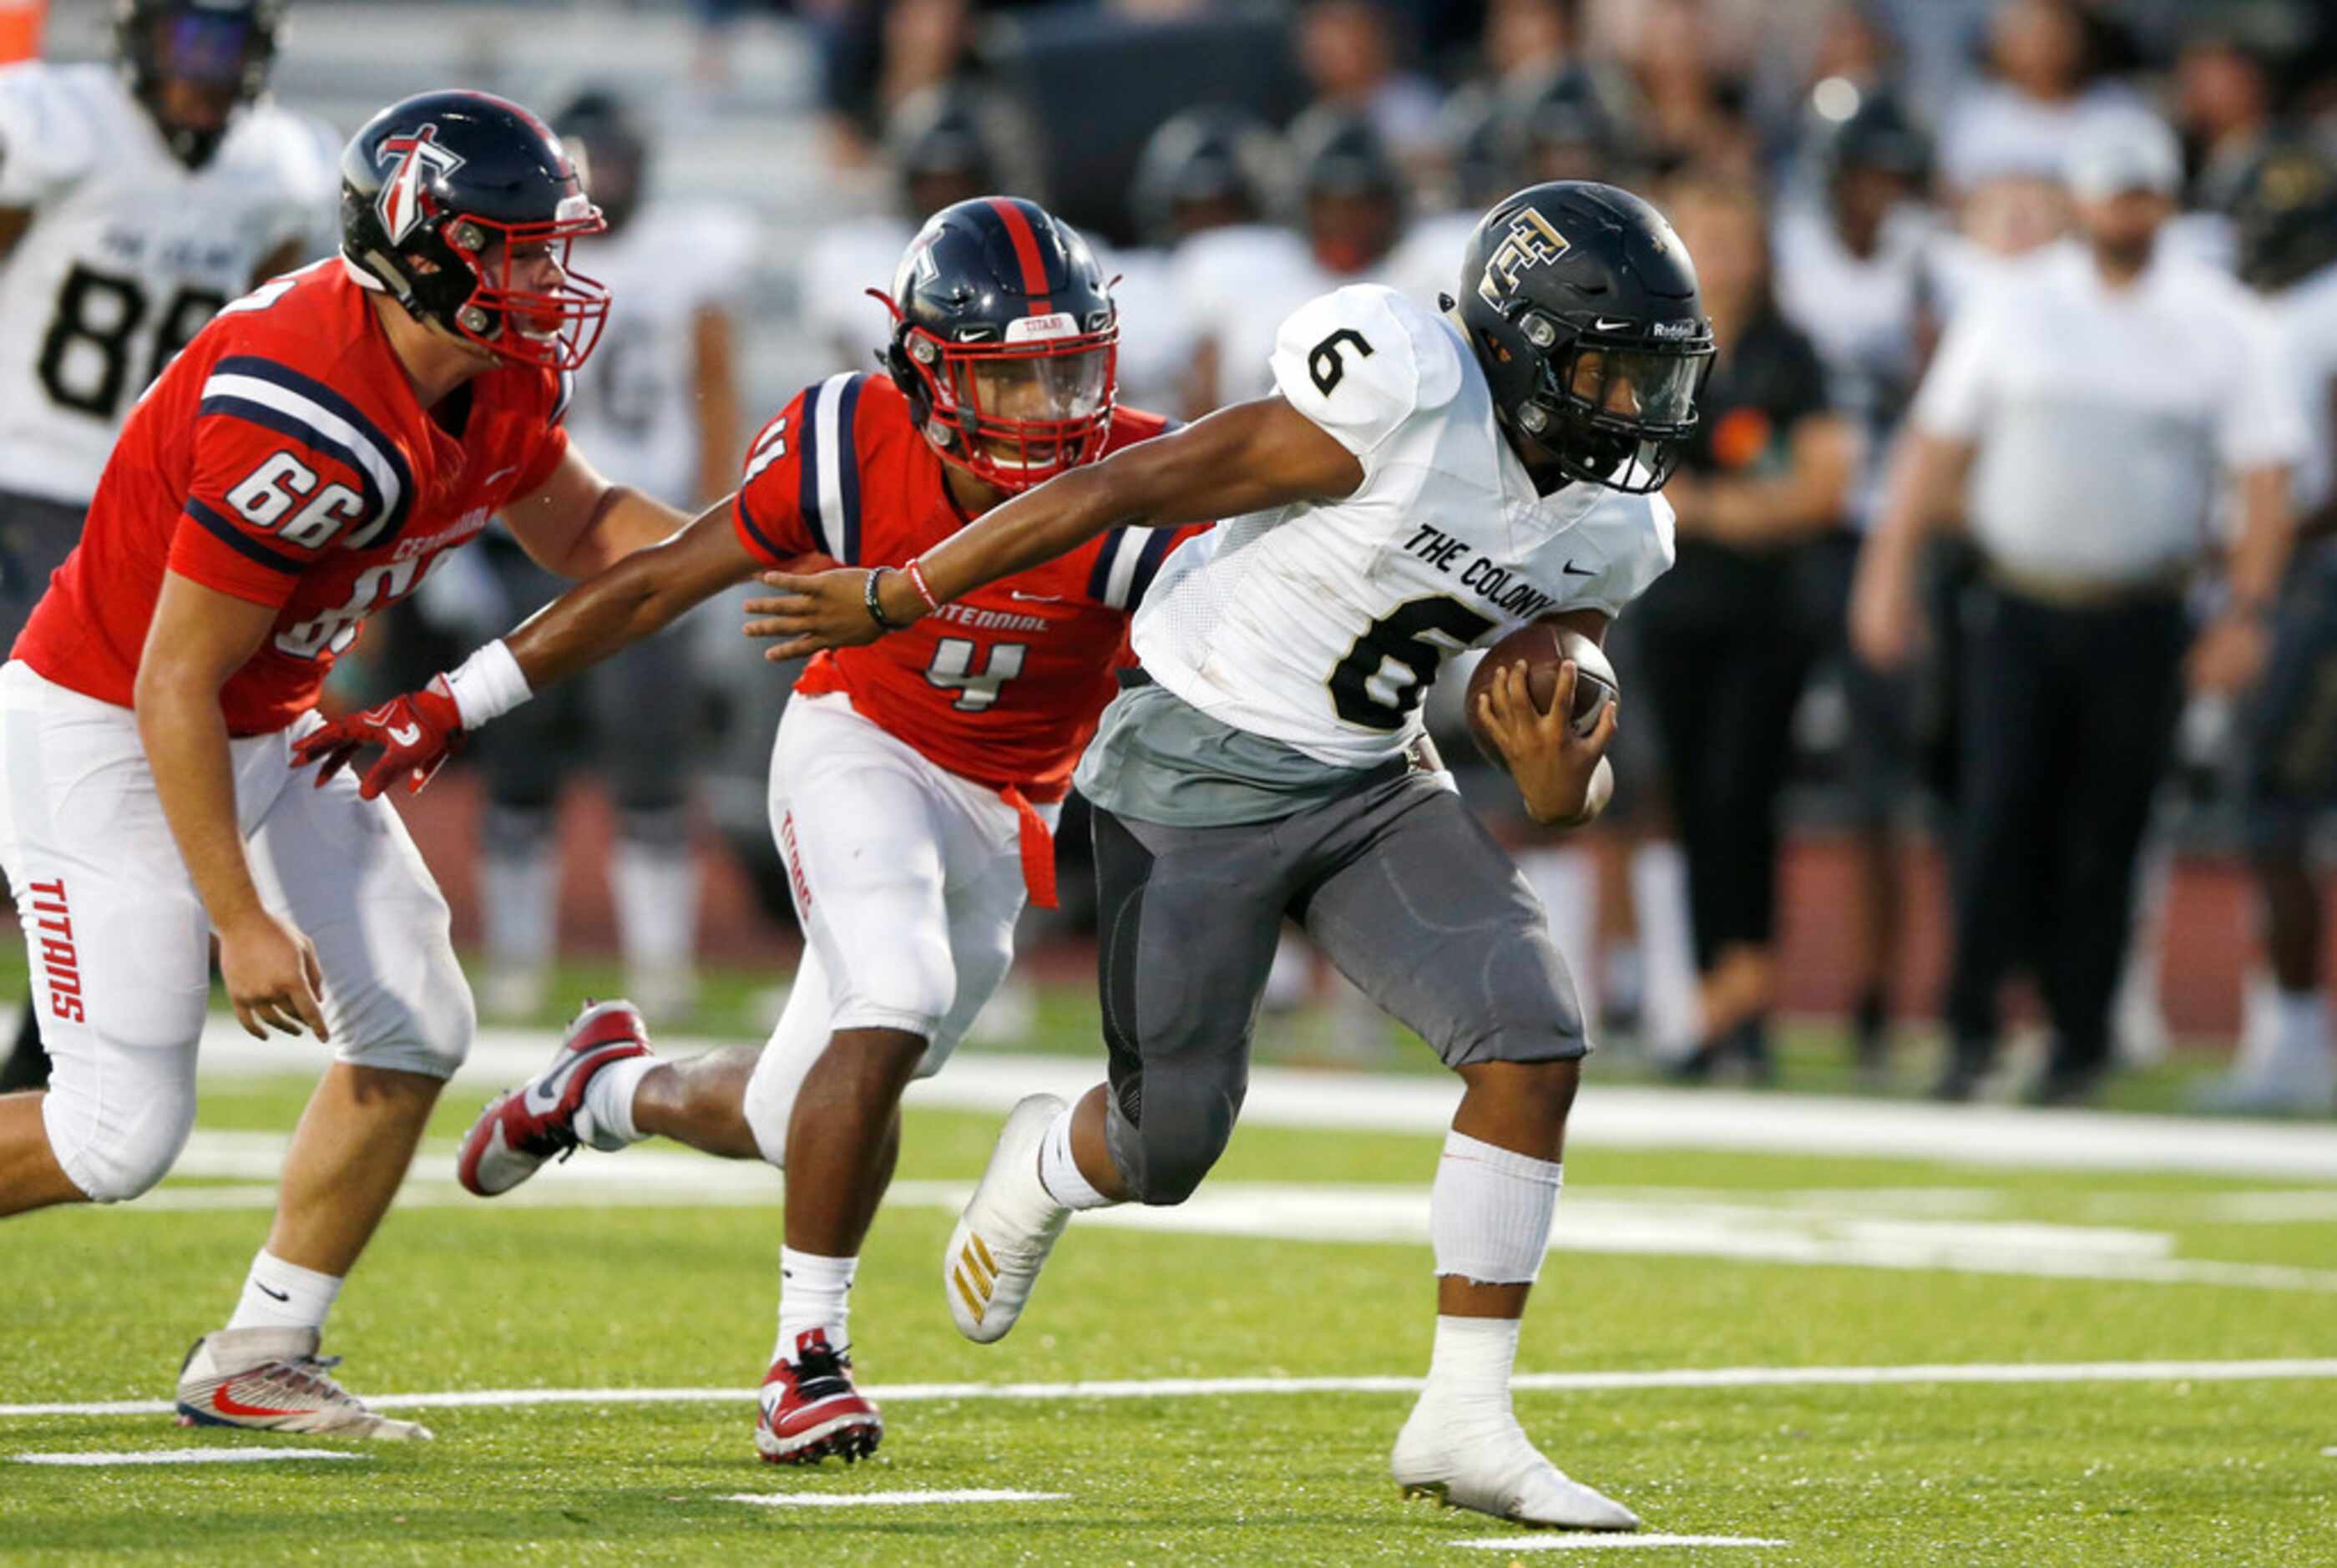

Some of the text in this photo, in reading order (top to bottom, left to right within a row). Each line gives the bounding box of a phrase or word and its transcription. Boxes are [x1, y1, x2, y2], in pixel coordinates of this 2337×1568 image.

[1308, 327, 1375, 399] 6
[224, 448, 365, 549] 66
[1404, 523, 1557, 620] THE COLONY
[924, 637, 1028, 712] 4
[1323, 591, 1500, 736] 6
[29, 878, 85, 1024] TITANS
